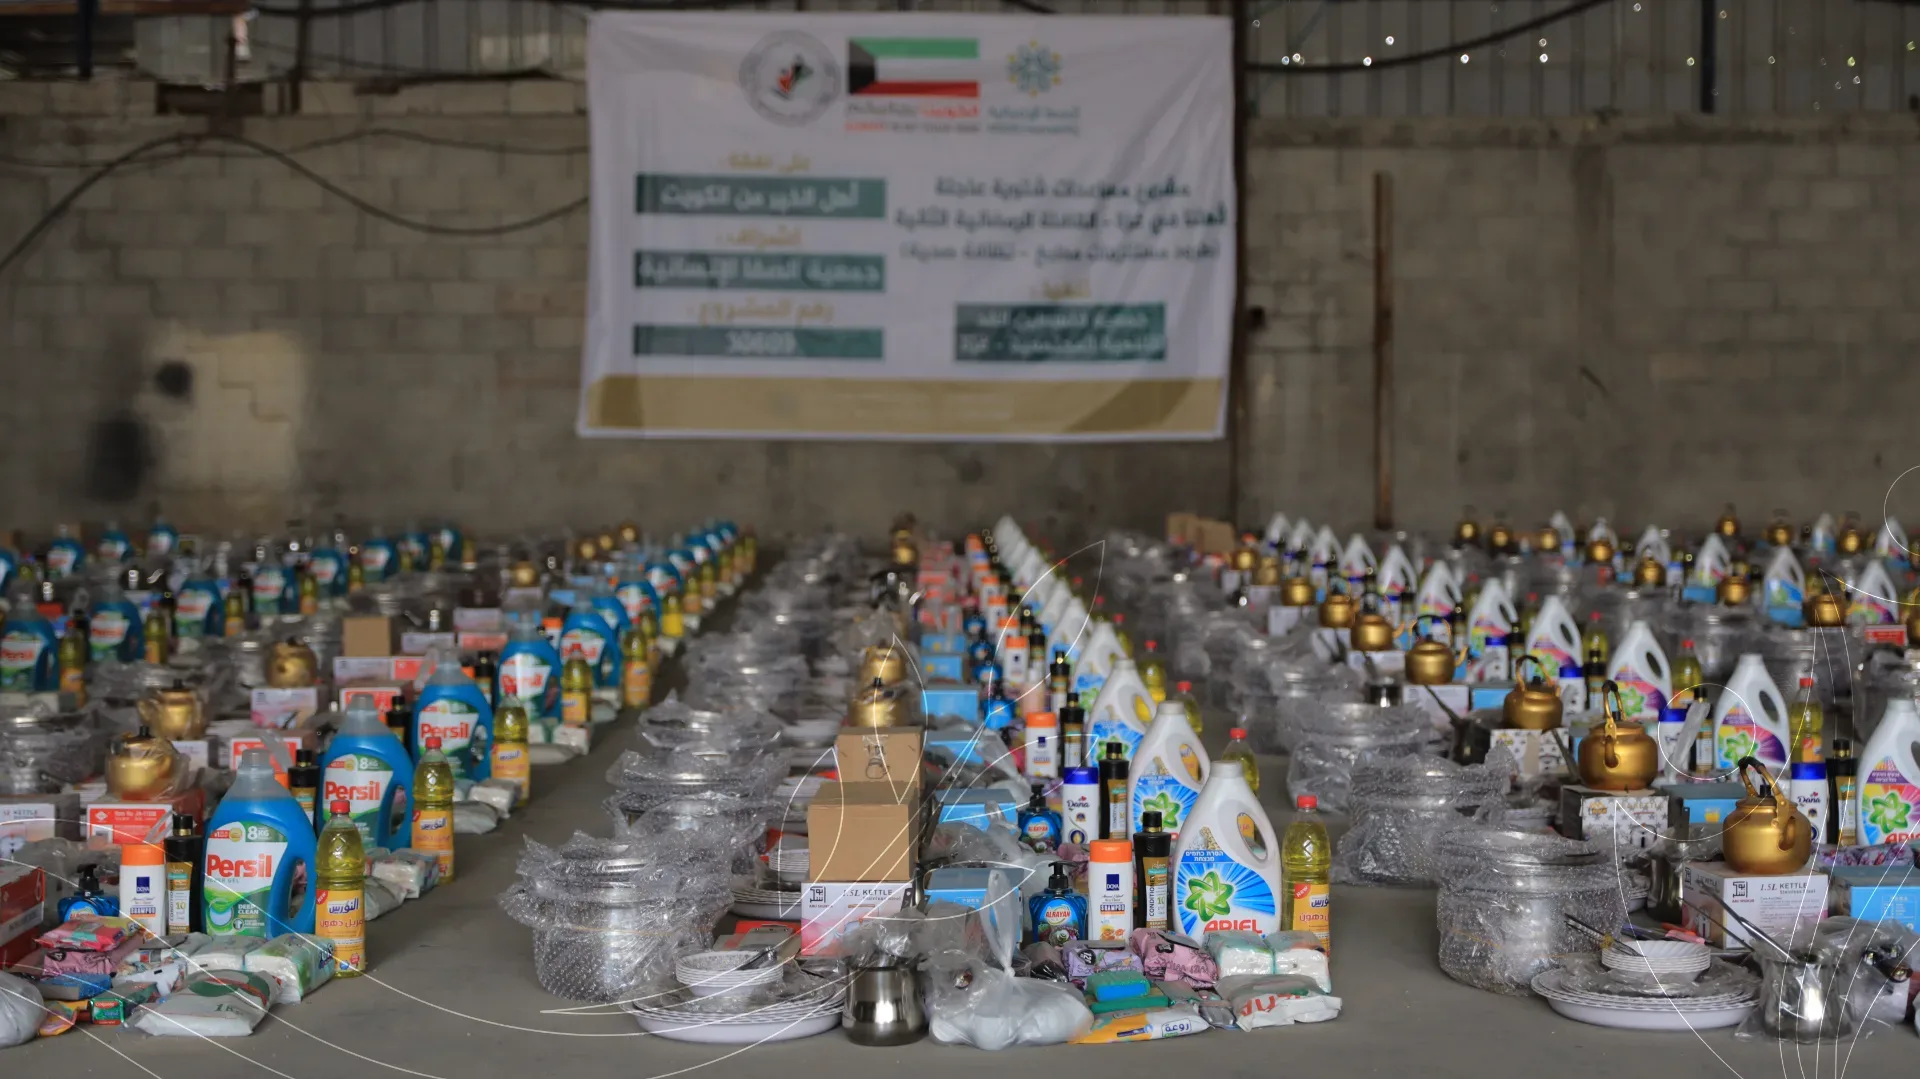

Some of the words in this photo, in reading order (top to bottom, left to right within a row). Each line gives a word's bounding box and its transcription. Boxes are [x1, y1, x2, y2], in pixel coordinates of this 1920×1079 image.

[819, 180, 860, 213] أهل
[807, 257, 880, 288] جمعية
[420, 722, 469, 743] Persil
[325, 781, 380, 801] Persil
[1066, 800, 1091, 808] Dana
[247, 826, 258, 840] 8
[207, 854, 273, 880] Persil
[1780, 882, 1807, 890] KETTLE
[176, 902, 187, 910] 10
[329, 899, 359, 914] النورس
[1165, 1023, 1189, 1032] روعة
